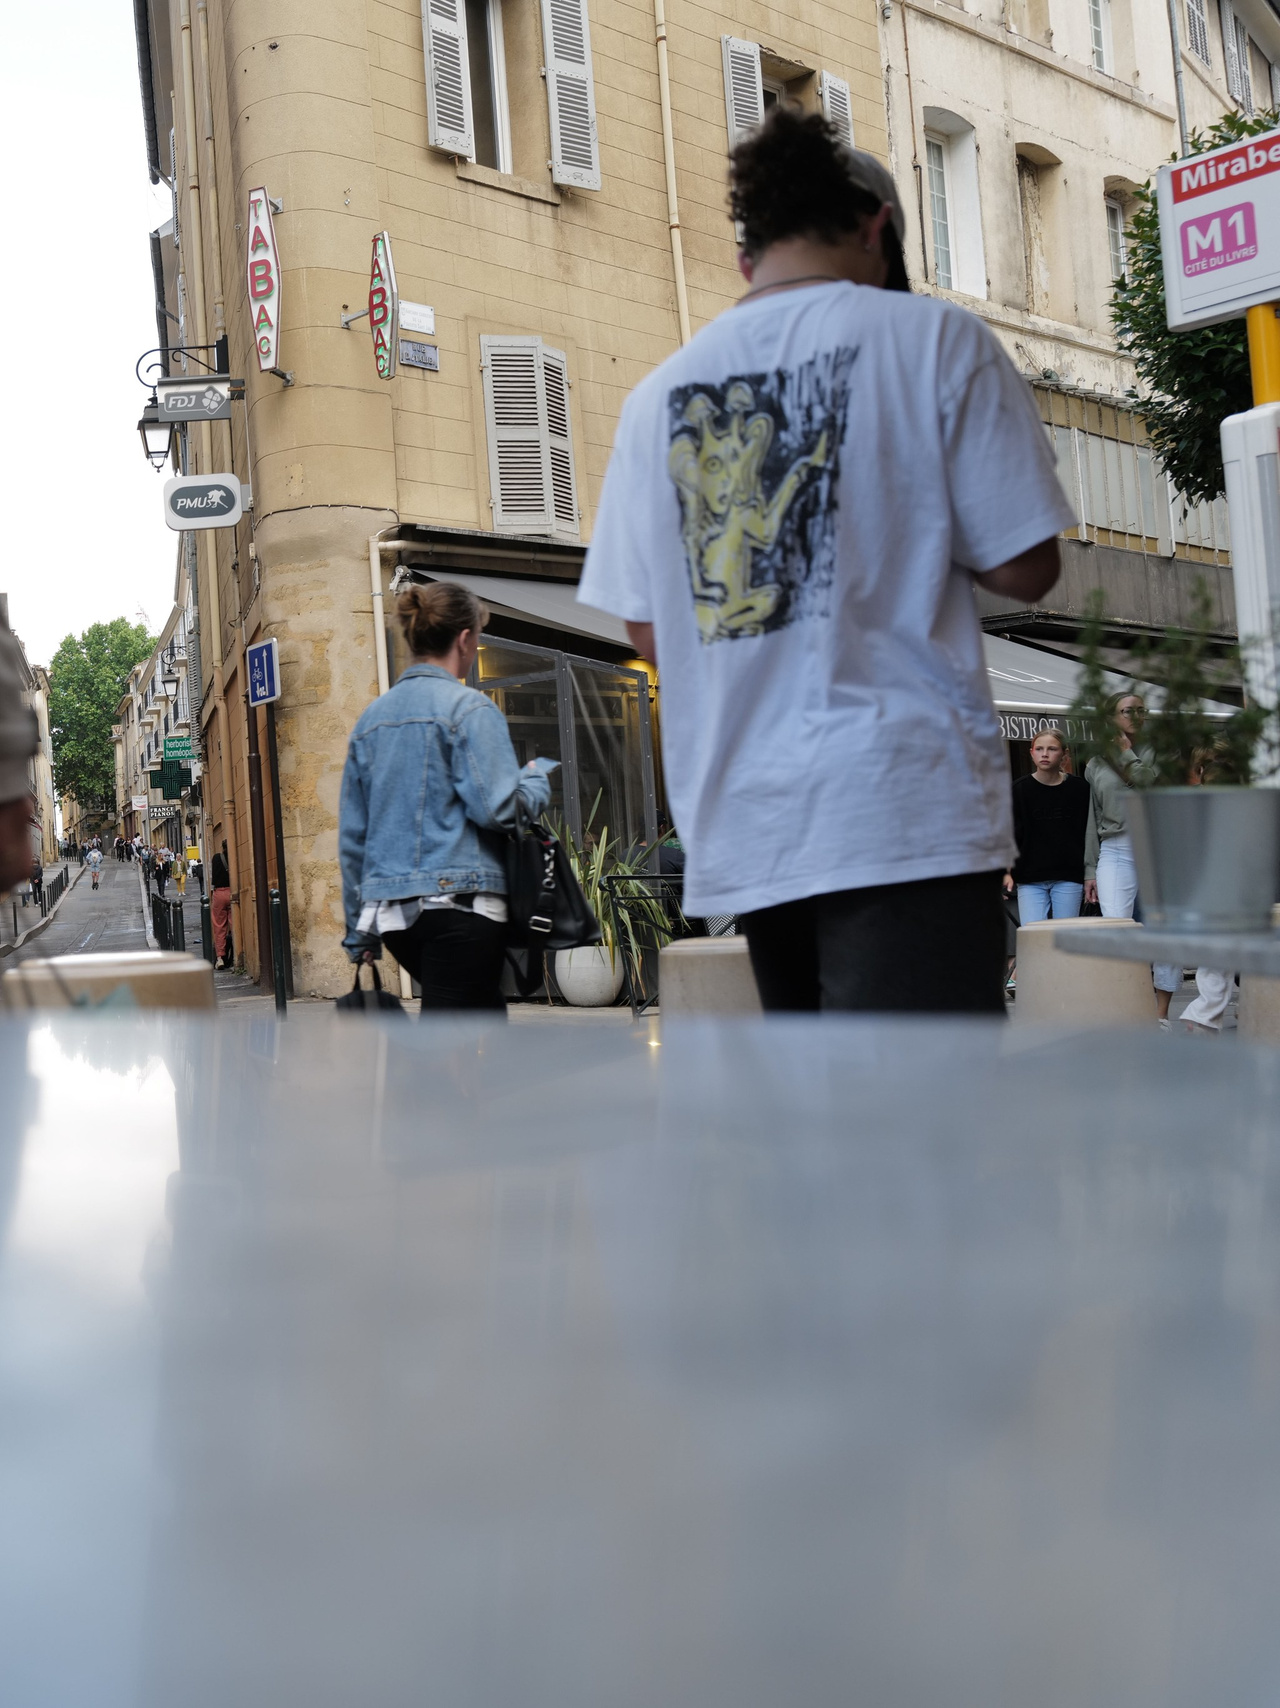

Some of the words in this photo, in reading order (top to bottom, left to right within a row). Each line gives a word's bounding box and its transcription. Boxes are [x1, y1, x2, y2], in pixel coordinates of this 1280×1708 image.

[1181, 145, 1280, 193] Mirabe
[1186, 210, 1247, 260] M1
[1185, 257, 1208, 275] CITÉ
[1209, 254, 1225, 268] DU
[1226, 245, 1257, 264] LIVRE
[249, 198, 275, 356] TABAC
[369, 237, 388, 373] TABAC
[168, 395, 196, 408] FDJ
[176, 497, 208, 510] PMU
[166, 739, 192, 748] herborist
[166, 748, 192, 758] homéopa
